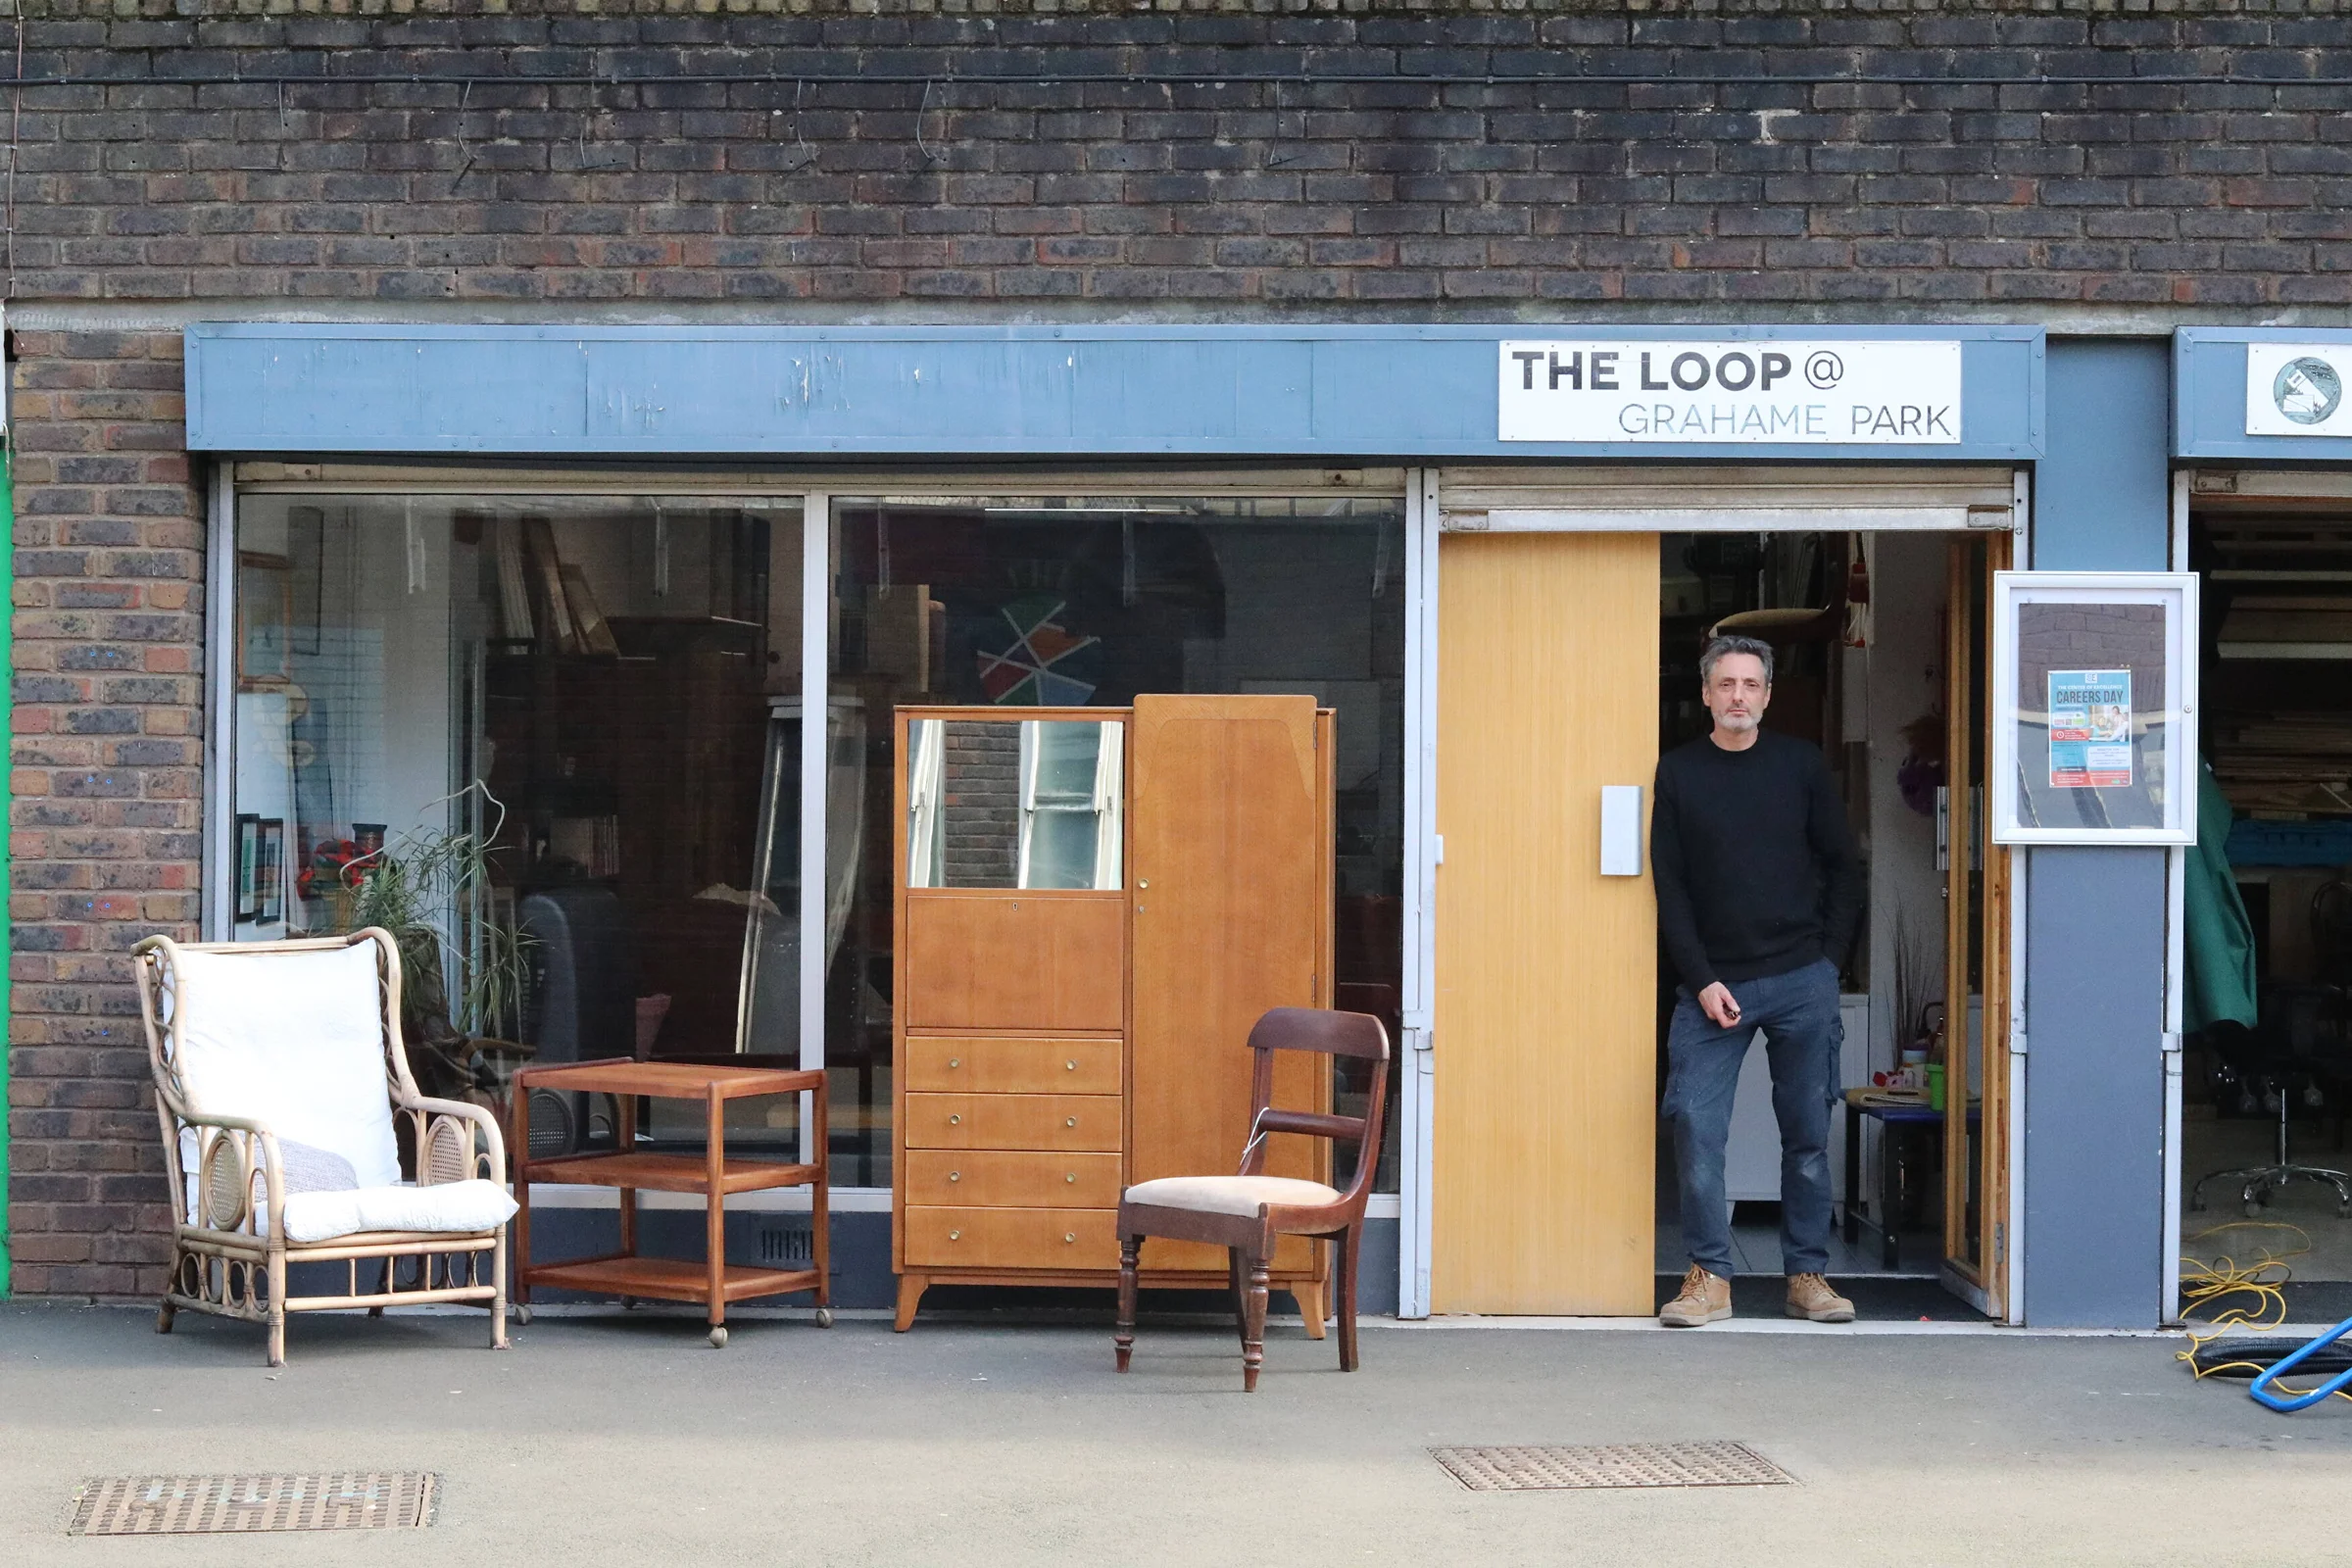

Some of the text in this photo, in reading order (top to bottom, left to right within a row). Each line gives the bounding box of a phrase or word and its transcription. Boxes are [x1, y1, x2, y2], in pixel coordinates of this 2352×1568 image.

[1512, 350, 1844, 392] THE LOOP @
[1618, 403, 1953, 436] GRAHAME PARK
[2056, 690, 2123, 704] CAREERS DAY
